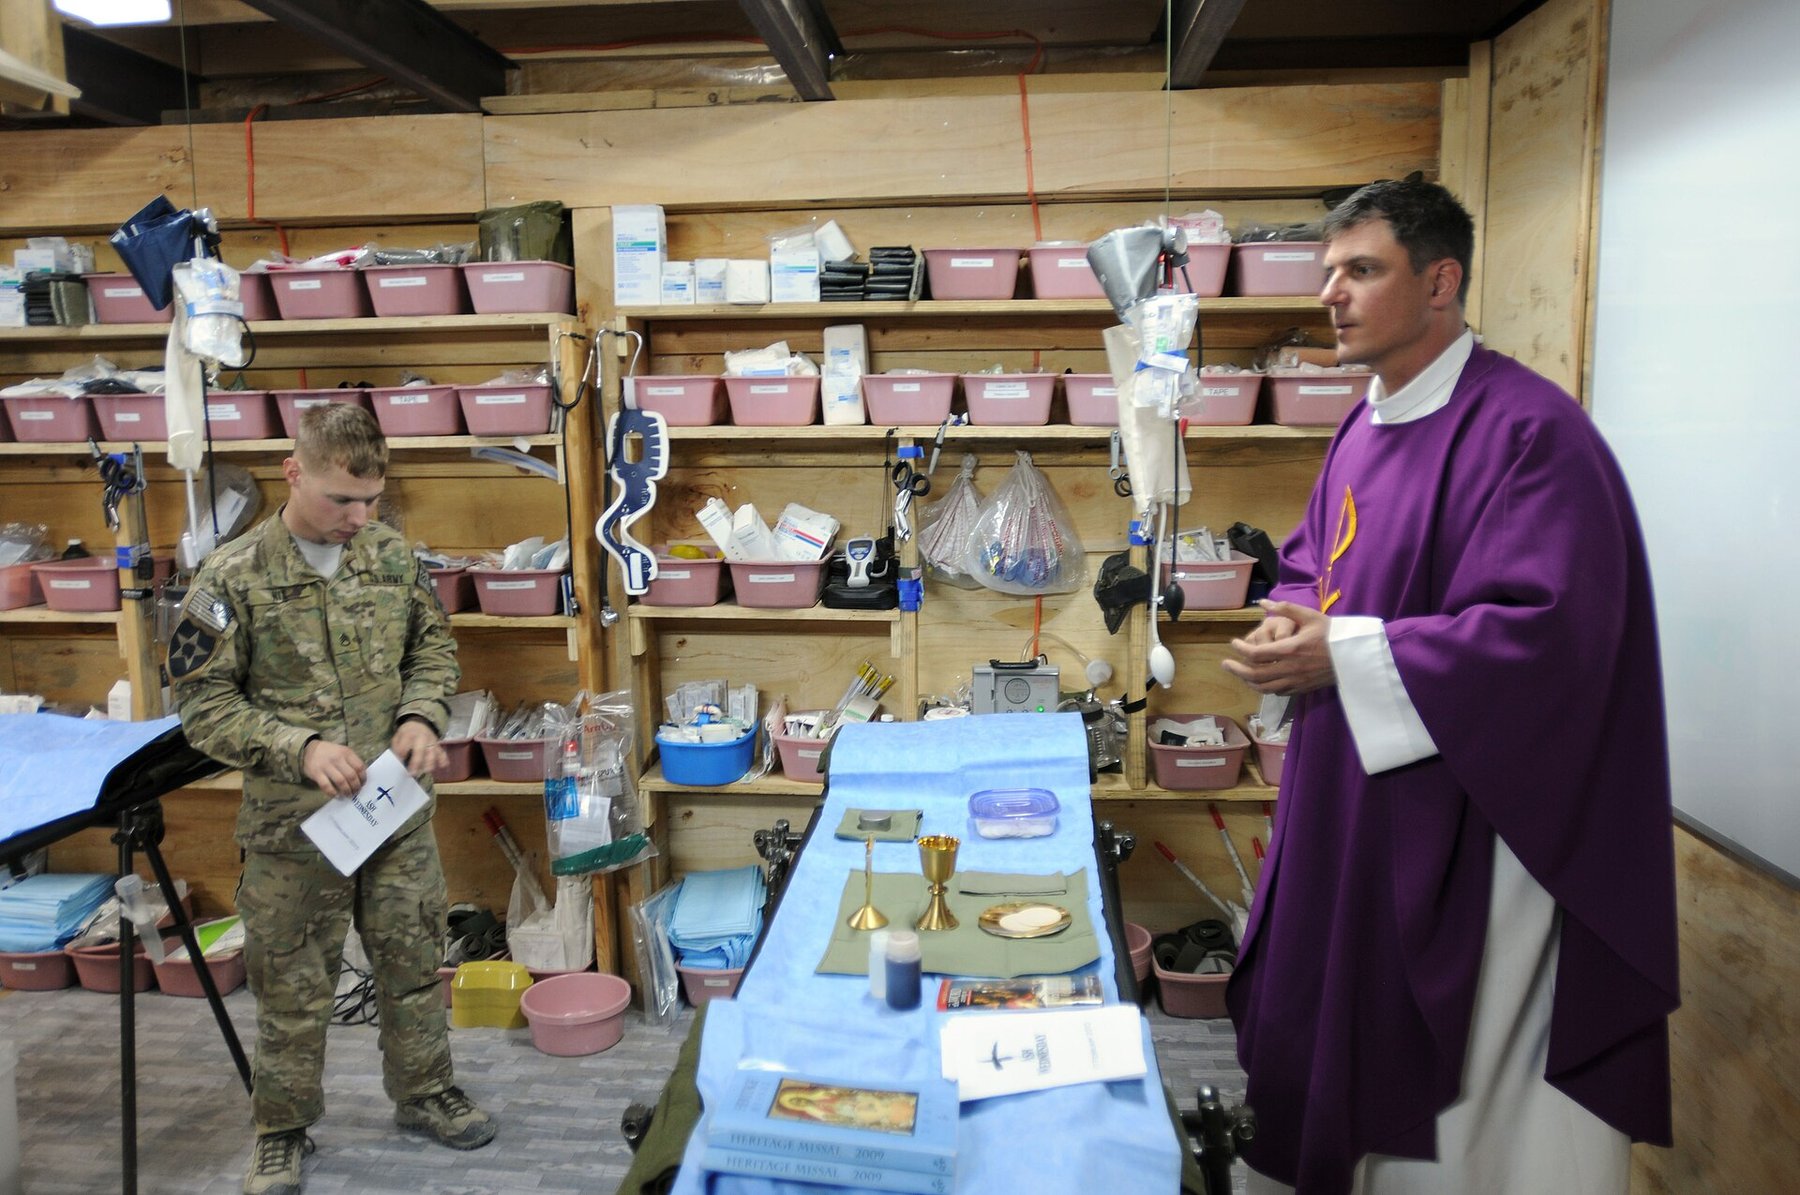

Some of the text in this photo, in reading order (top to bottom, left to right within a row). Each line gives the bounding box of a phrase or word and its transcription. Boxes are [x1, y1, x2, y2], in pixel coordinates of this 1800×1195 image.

[382, 574, 404, 584] ARMY
[352, 794, 379, 828] WEDNESDAY
[364, 799, 377, 813] ASH
[1022, 1049, 1034, 1061] ASH
[1035, 1034, 1051, 1075] WEDNESDAY
[730, 1133, 885, 1161] HERITAGE MISSAL 2009
[726, 1156, 883, 1183] HERITAGE MISSAL 2009
